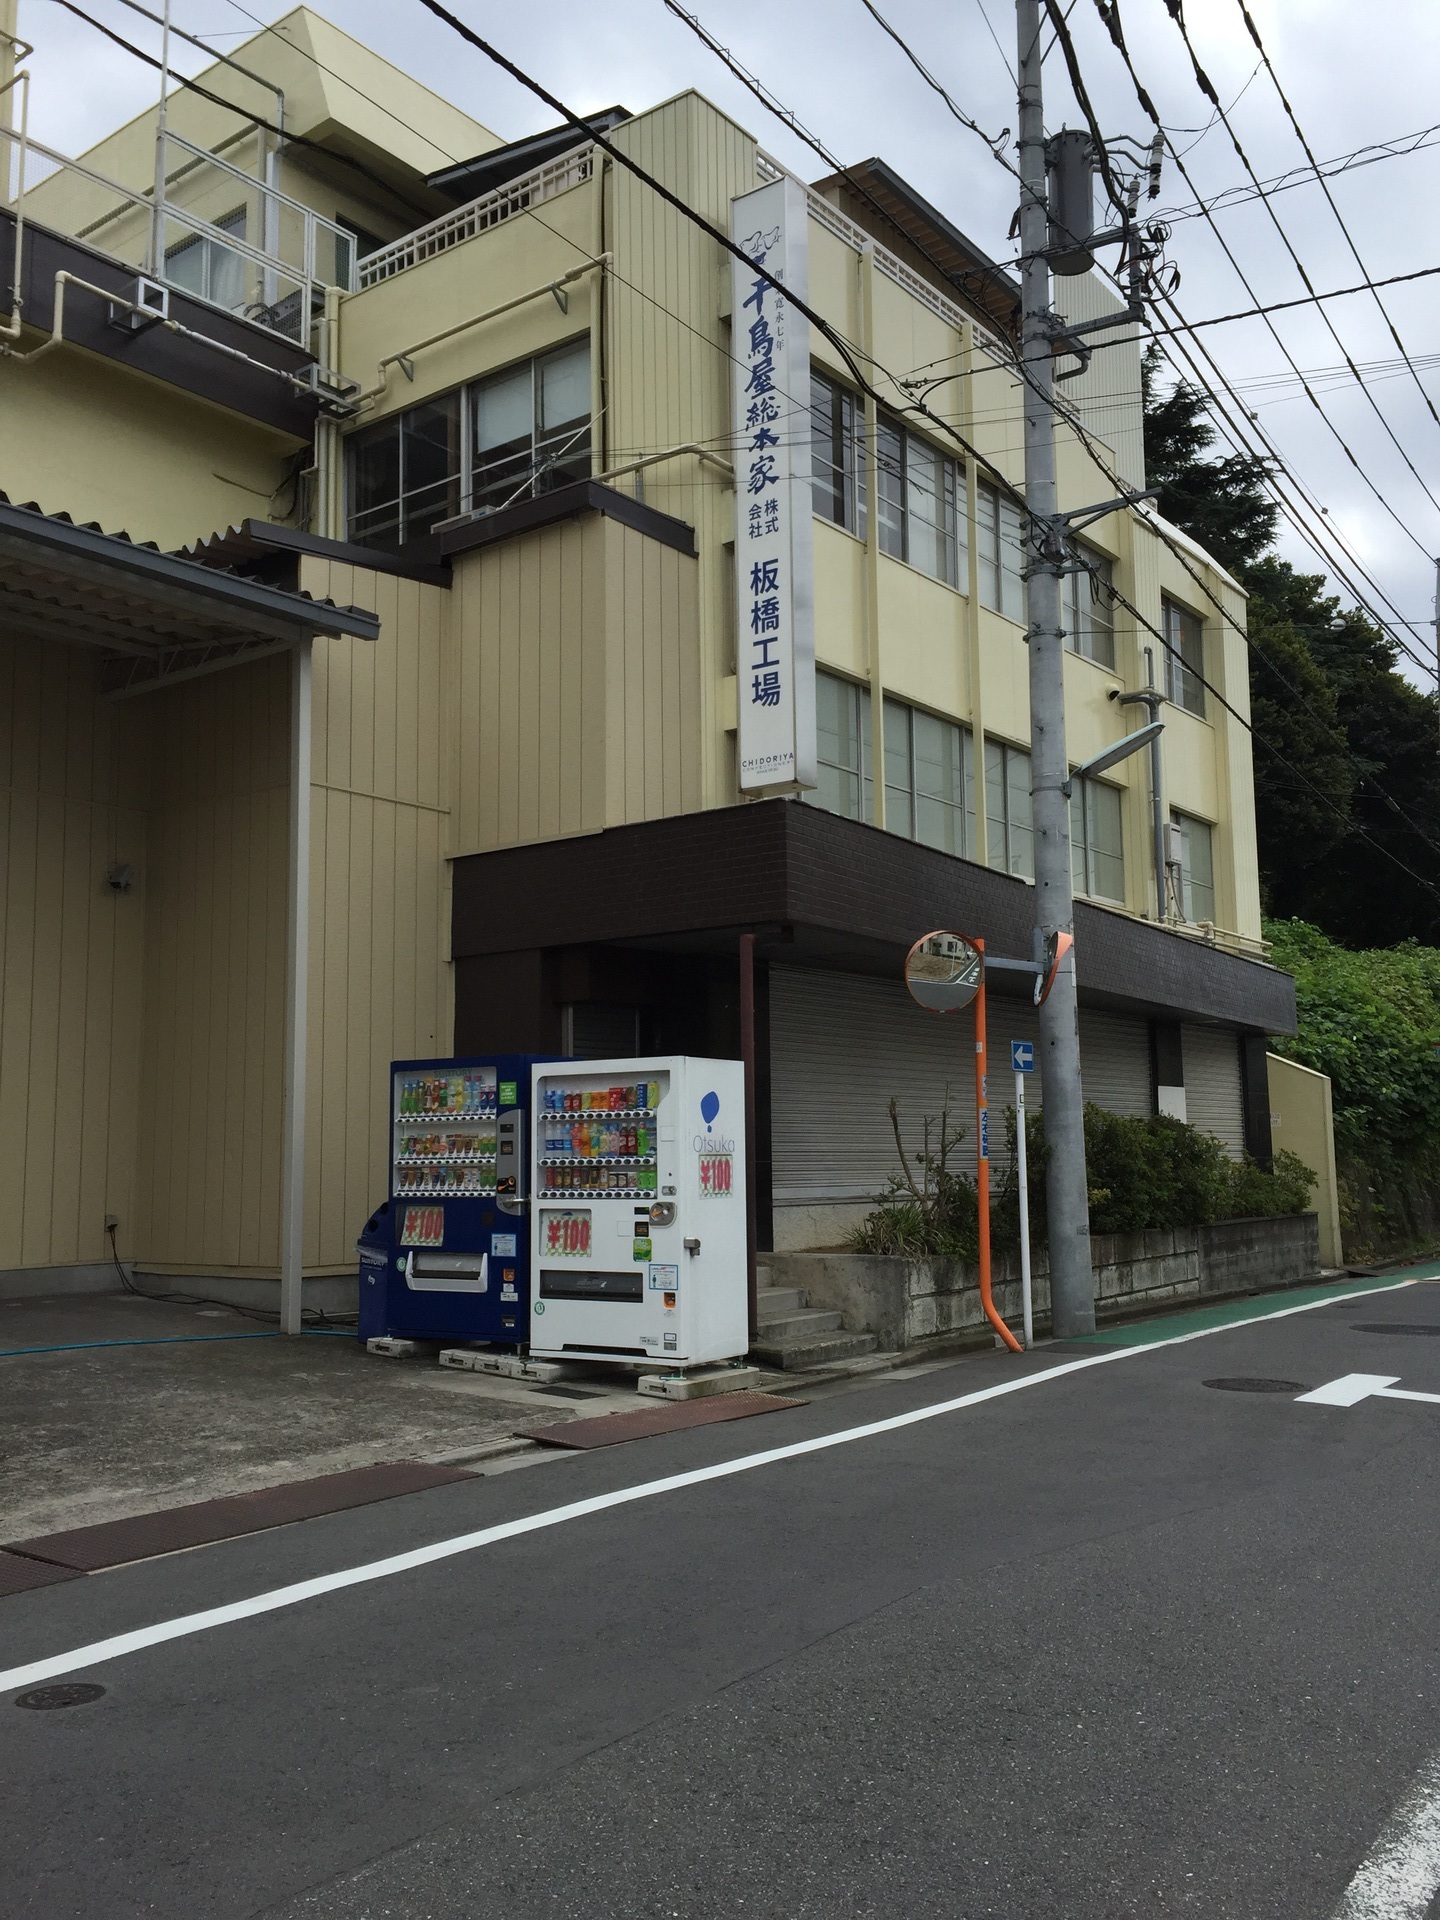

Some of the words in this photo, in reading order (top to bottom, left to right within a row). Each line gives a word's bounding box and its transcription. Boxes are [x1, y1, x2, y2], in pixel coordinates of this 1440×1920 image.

[742, 276, 781, 495] 千鳥屋総本家
[750, 558, 781, 707] 板橋工場
[742, 752, 794, 768] CHIDORIYA
[693, 1135, 735, 1153] Otsuka
[701, 1158, 731, 1192] ¥100
[405, 1208, 443, 1241] ¥100
[547, 1219, 590, 1252] ¥100
